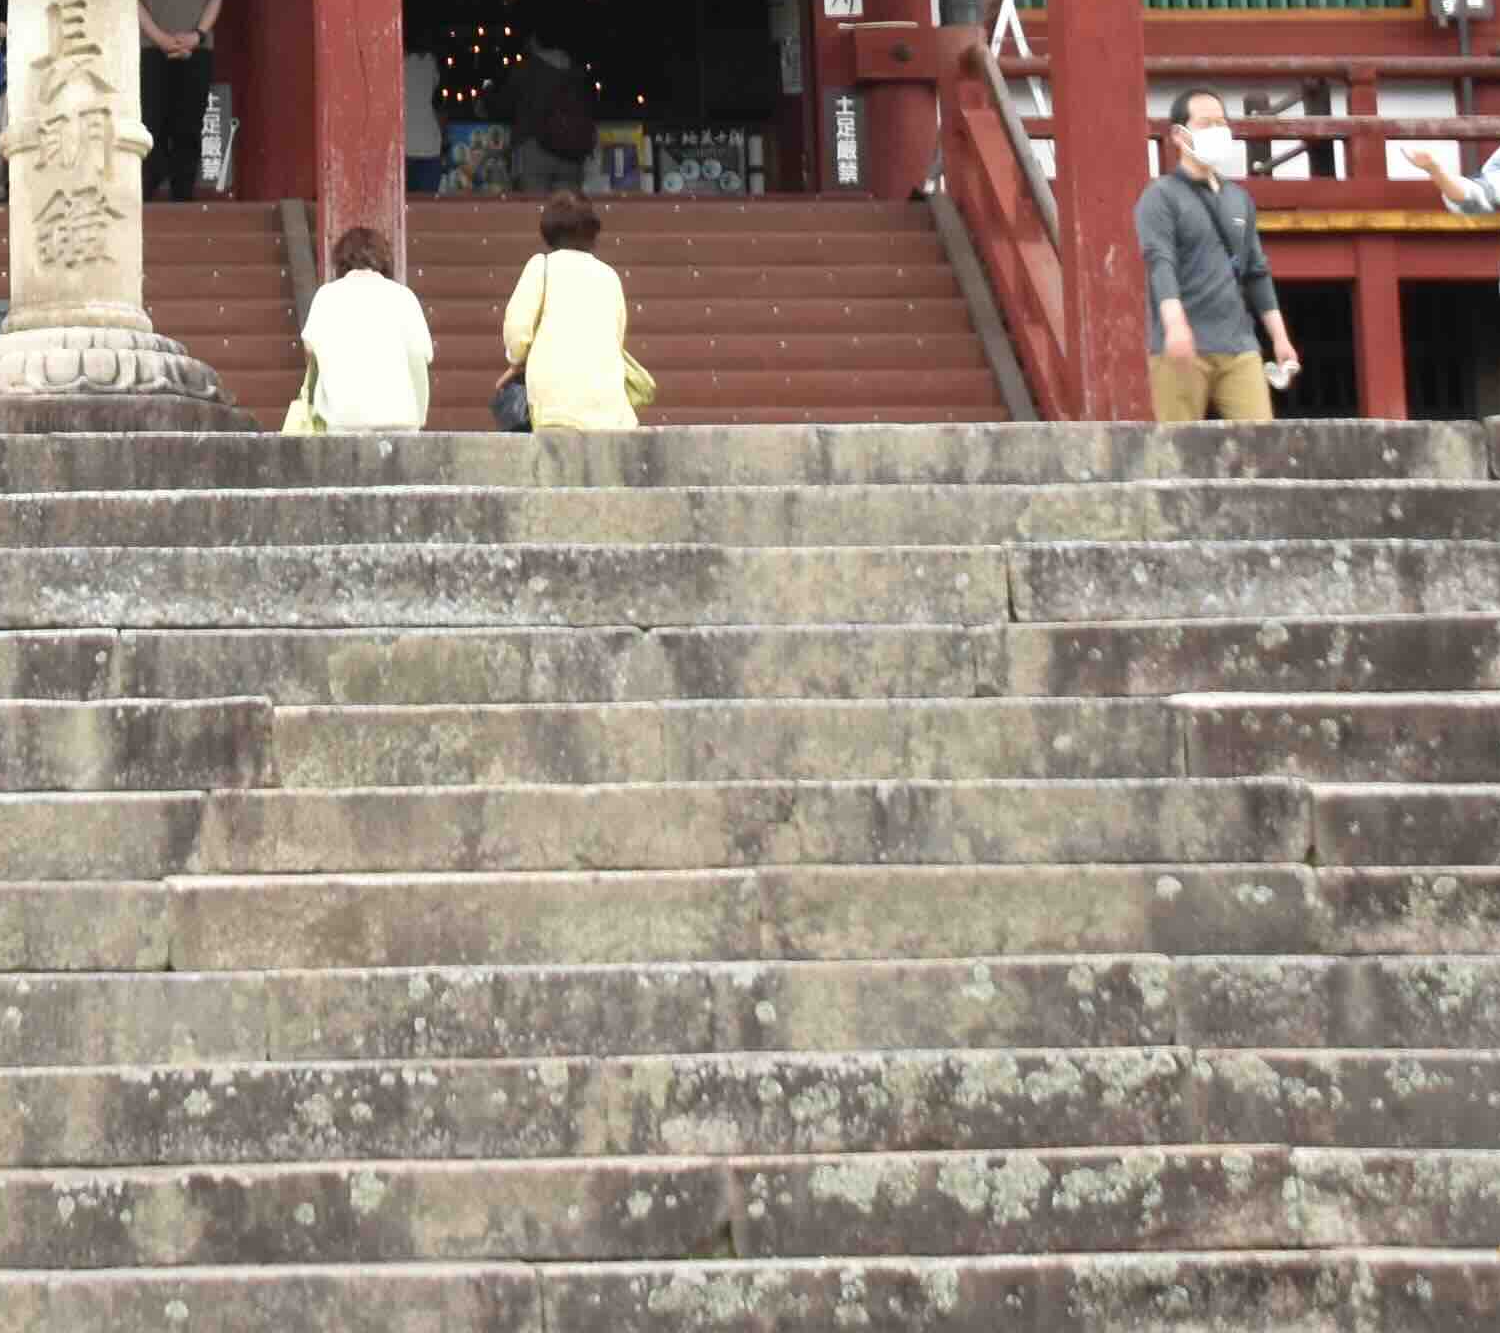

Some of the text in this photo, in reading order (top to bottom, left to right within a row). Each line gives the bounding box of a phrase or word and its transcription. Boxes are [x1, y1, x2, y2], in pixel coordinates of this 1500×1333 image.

[201, 92, 222, 181] 土足厳禁
[835, 95, 859, 185] 土足厳禁
